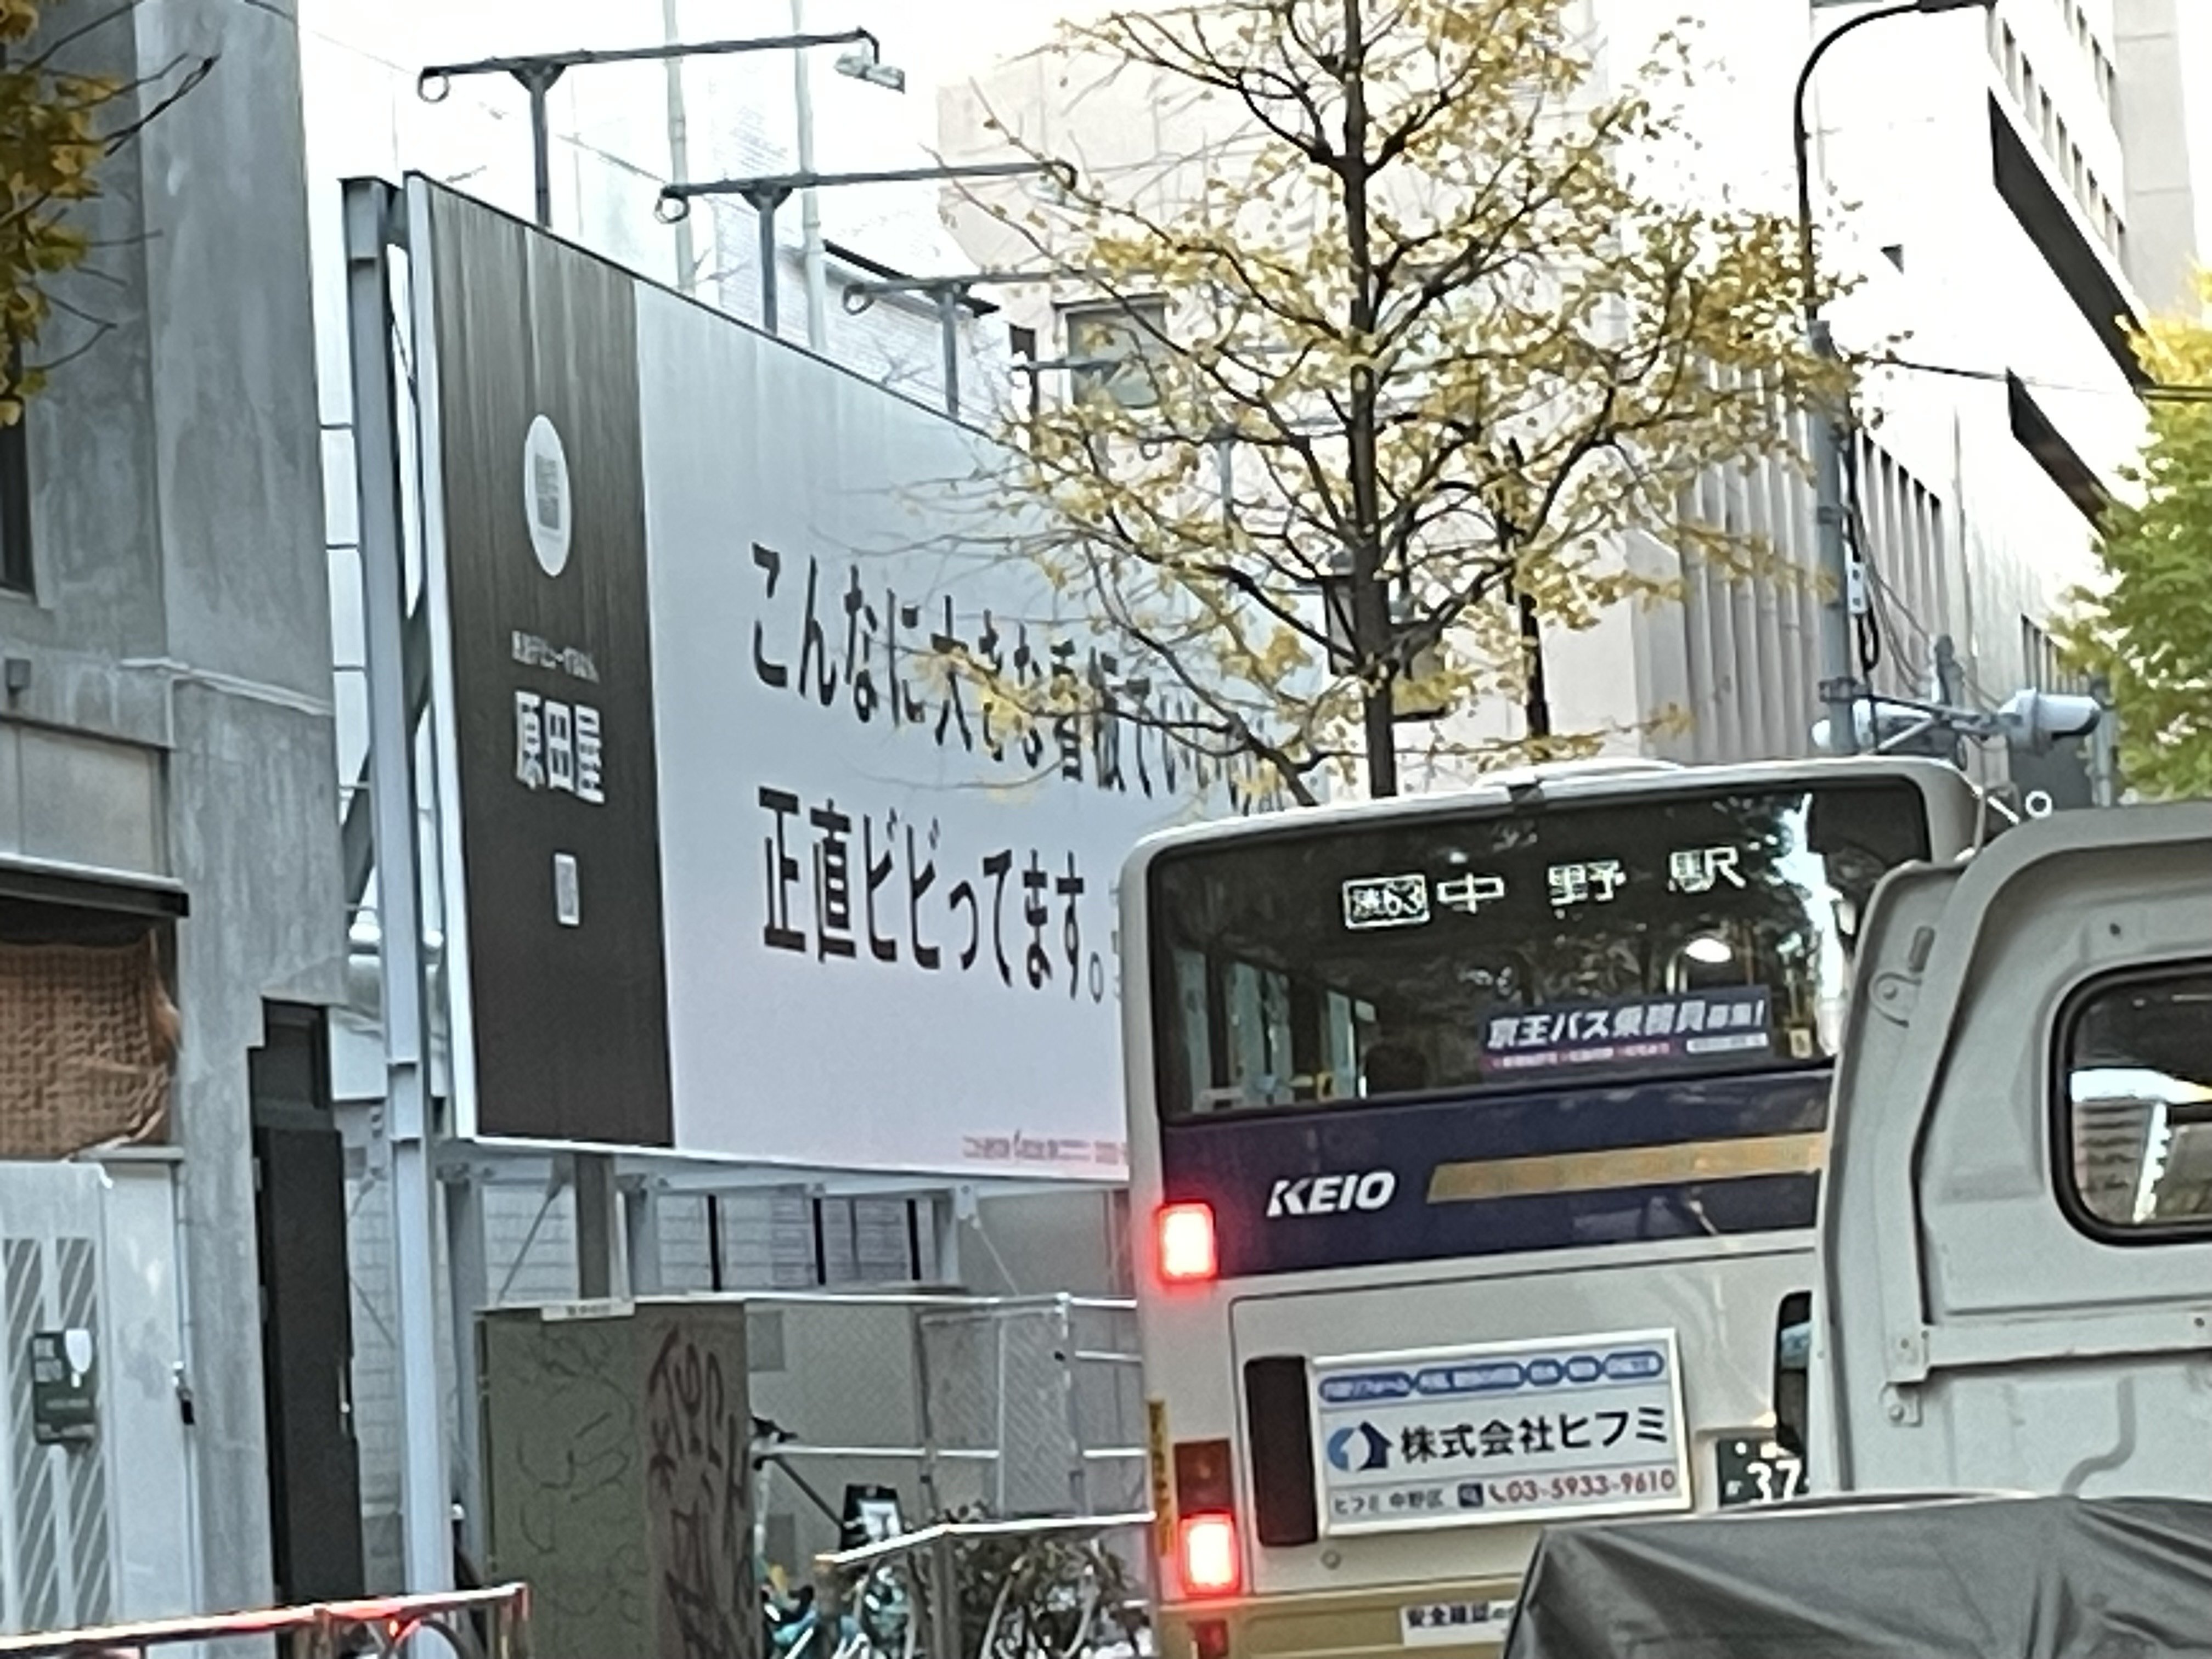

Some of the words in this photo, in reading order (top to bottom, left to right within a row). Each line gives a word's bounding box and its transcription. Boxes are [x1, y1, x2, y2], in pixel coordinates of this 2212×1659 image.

[758, 786, 1105, 1004] 正直ビビってます。
[1436, 846, 1747, 914] 中野駅
[1267, 1171, 1396, 1218] KEIO
[1400, 1406, 1668, 1463] 株式会社ヒフミ
[1505, 1468, 1676, 1503] 03-5933-9610
